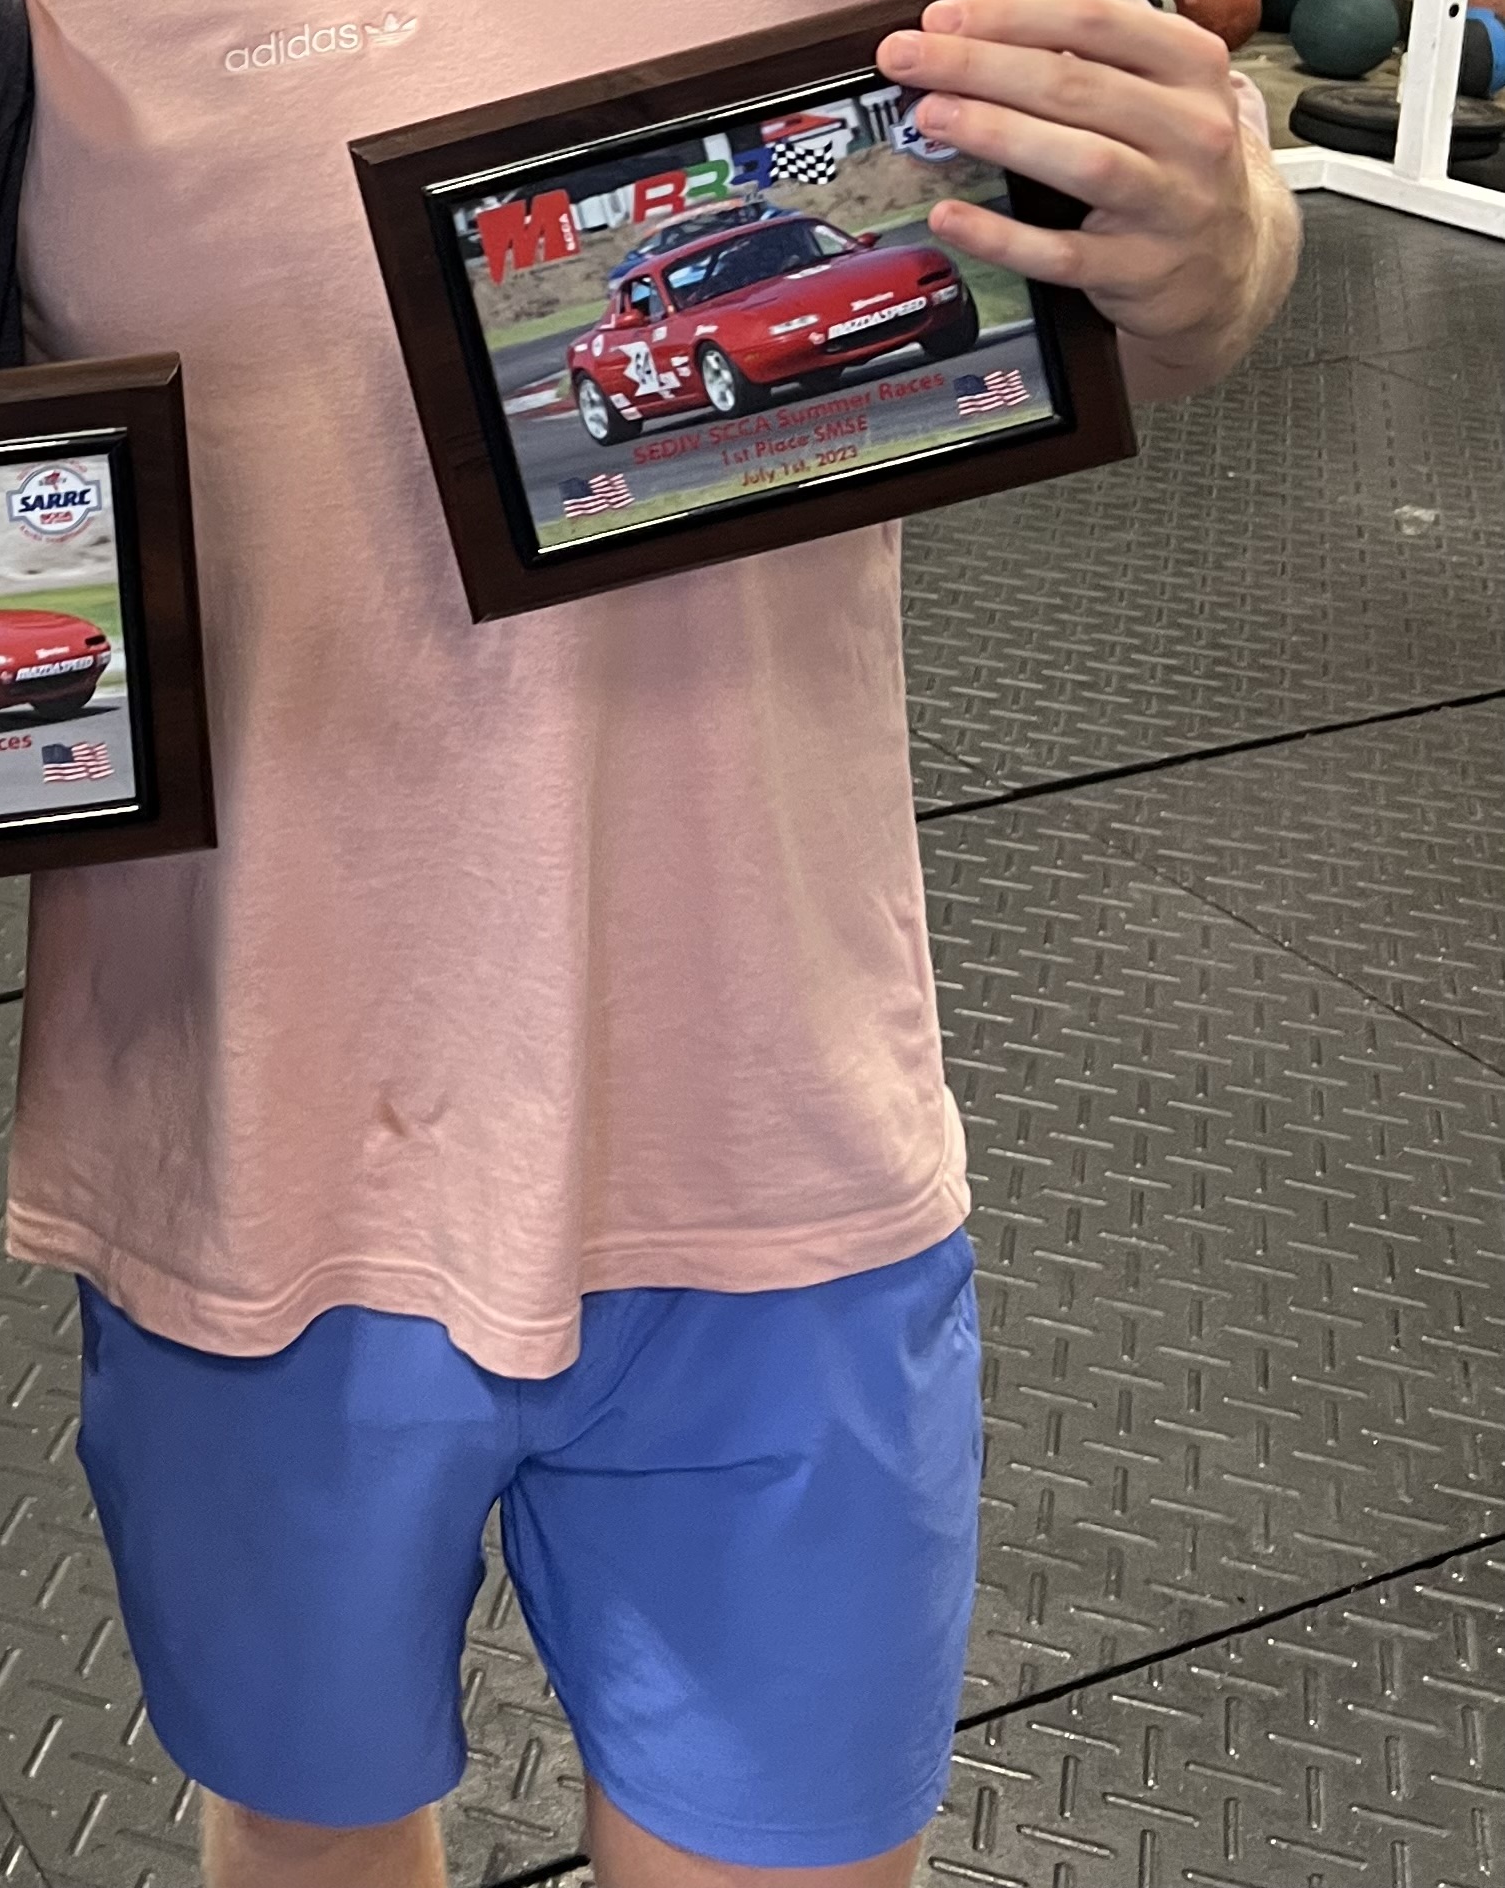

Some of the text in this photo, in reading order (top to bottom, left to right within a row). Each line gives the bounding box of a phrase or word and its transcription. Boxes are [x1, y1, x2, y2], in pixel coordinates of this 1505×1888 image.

[225, 23, 360, 72] adidas
[710, 417, 772, 445] SCCA
[777, 392, 871, 427] Summer
[879, 373, 945, 401] Races
[755, 436, 810, 457] Place
[814, 416, 869, 442] SMSE
[816, 445, 858, 467] 2023
[18, 488, 92, 513] SARRC
